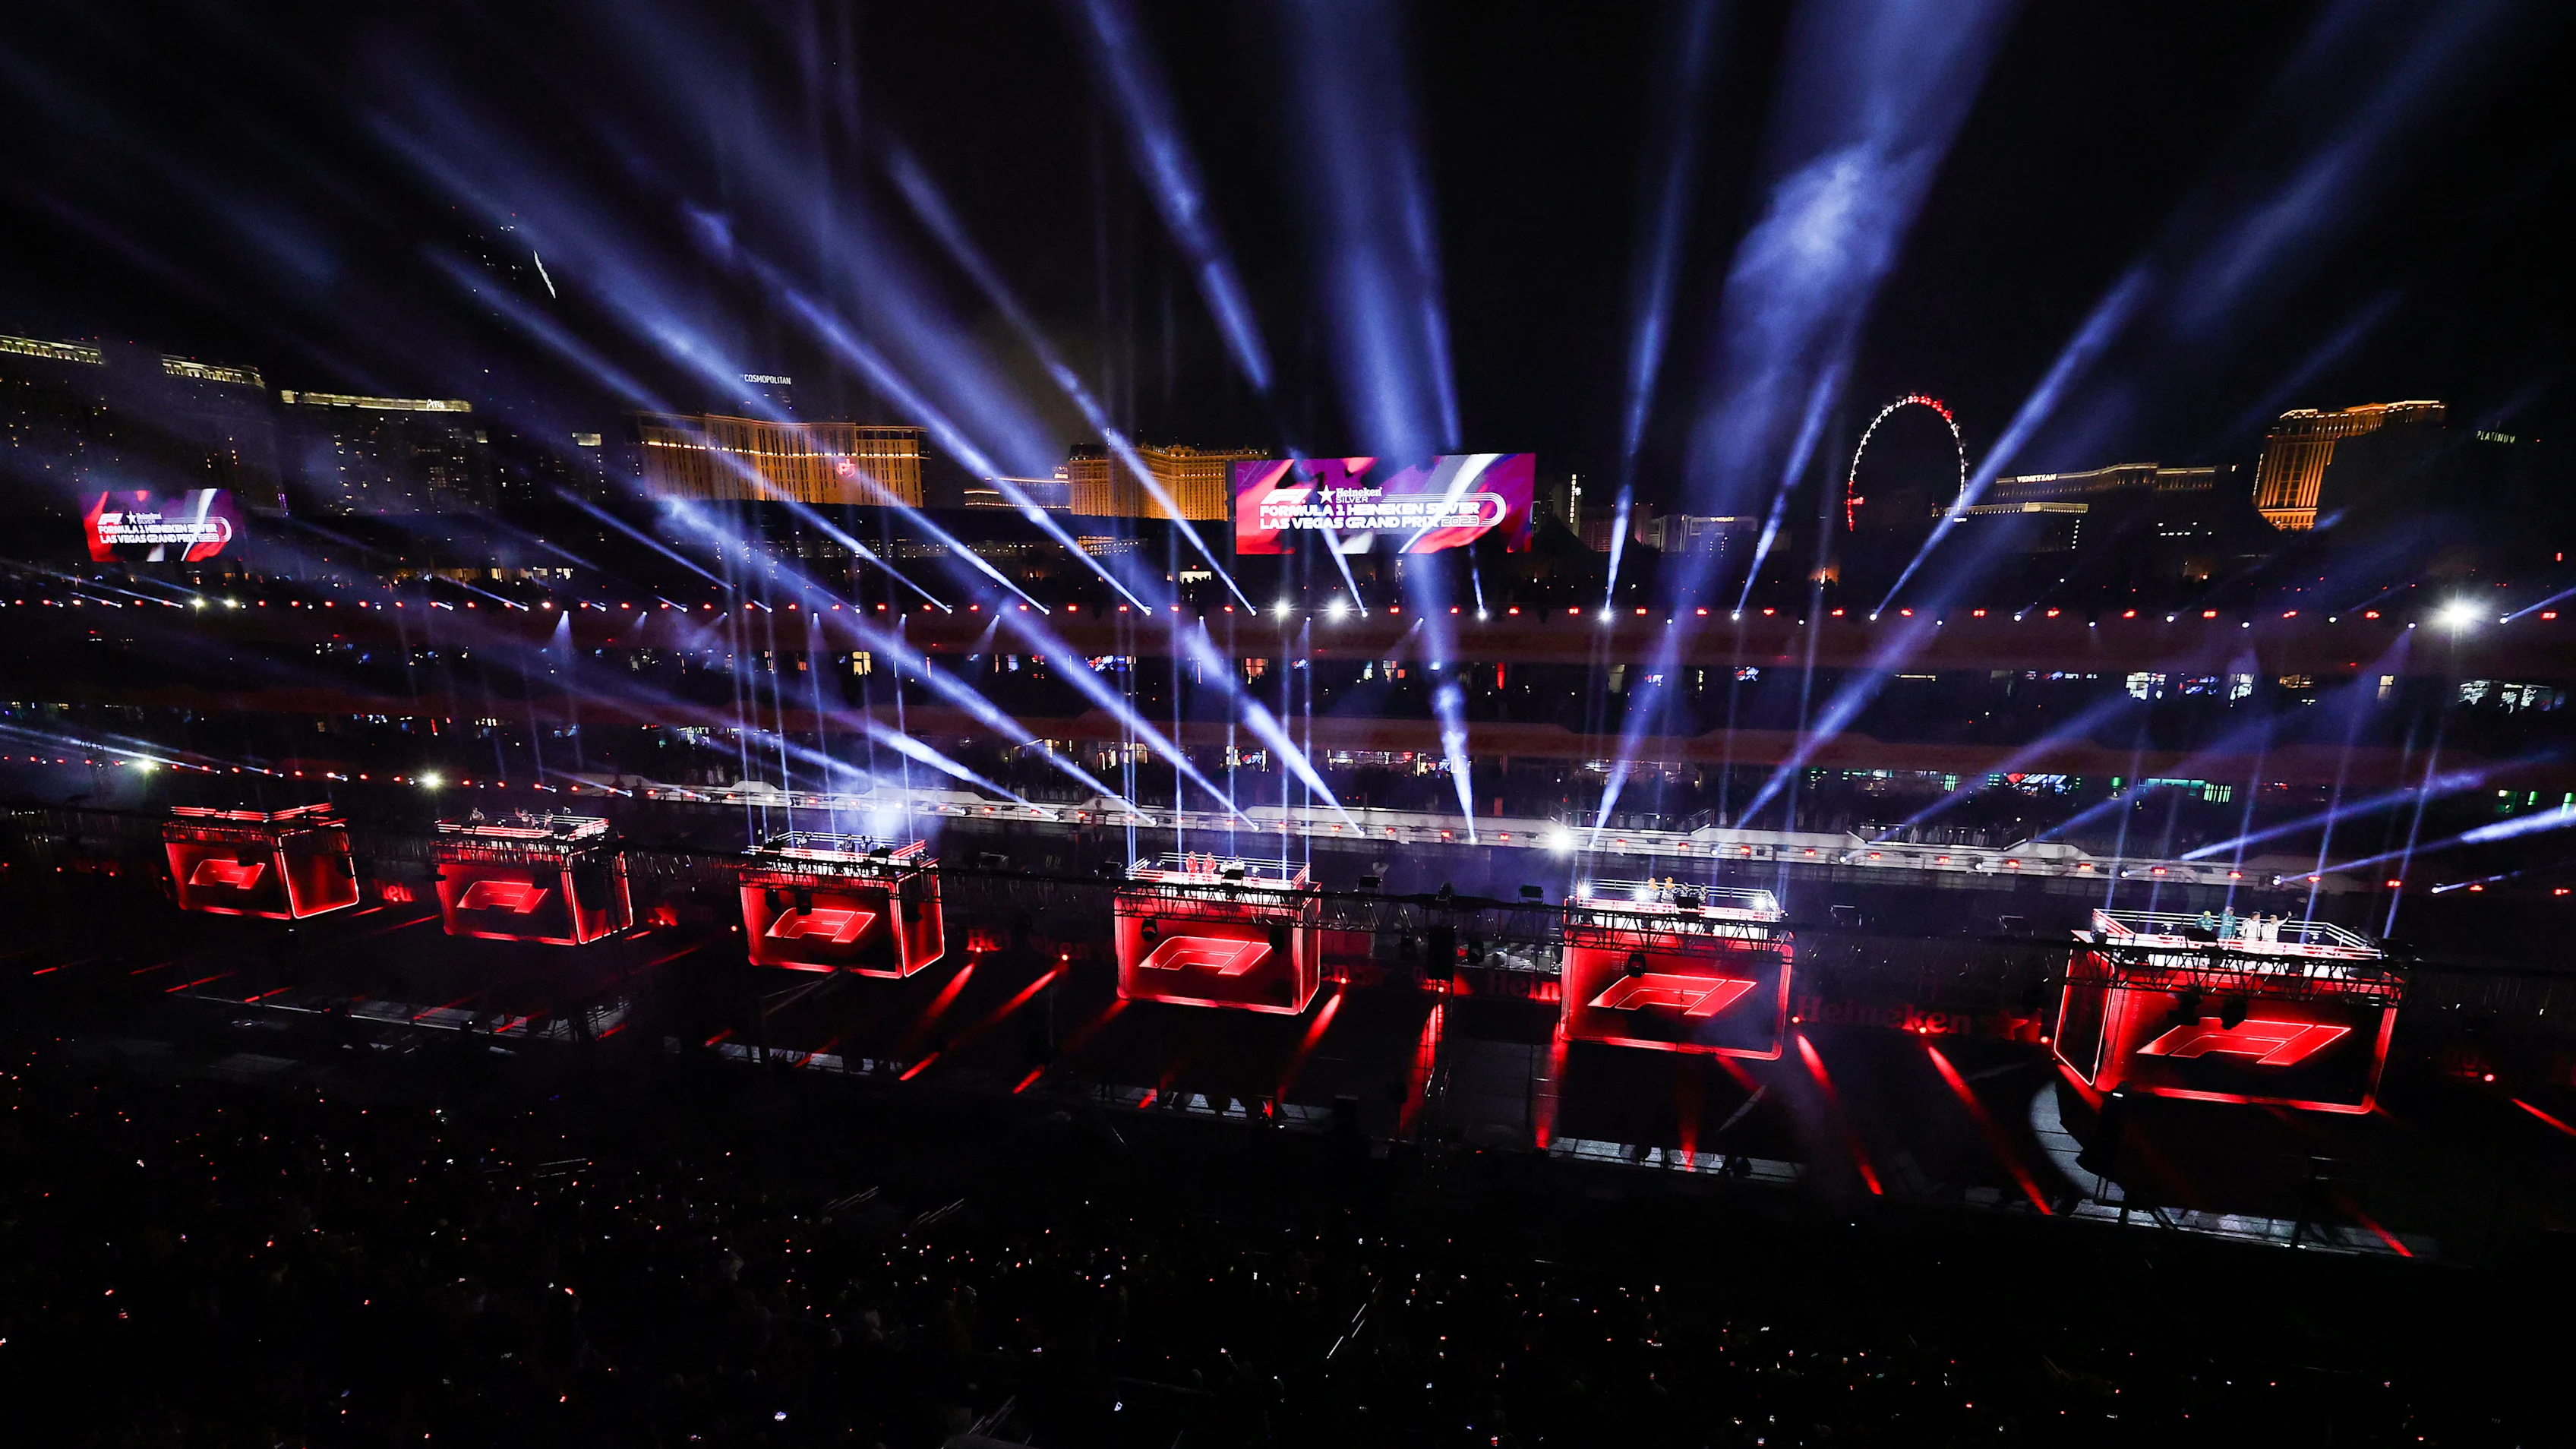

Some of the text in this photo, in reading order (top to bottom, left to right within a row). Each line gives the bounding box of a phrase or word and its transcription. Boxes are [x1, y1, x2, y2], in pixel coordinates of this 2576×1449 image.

[744, 374, 792, 385] COSMOPOLITAN
[2476, 430, 2516, 444] PLATINUM
[2016, 473, 2057, 483] VENETIAN
[1335, 487, 1382, 497] Heineken
[1260, 504, 1334, 516] FORMULA
[1335, 504, 1346, 516] 1
[1346, 503, 1425, 516] HEINEKEN
[1260, 516, 1480, 529] LAS VEGAS GRAND PRIX 2023
[97, 525, 139, 535] FORMULA
[144, 524, 188, 534] HEINEKEN
[99, 534, 118, 544] LAS
[117, 534, 147, 543] VEGAS
[147, 534, 177, 543] GRAND
